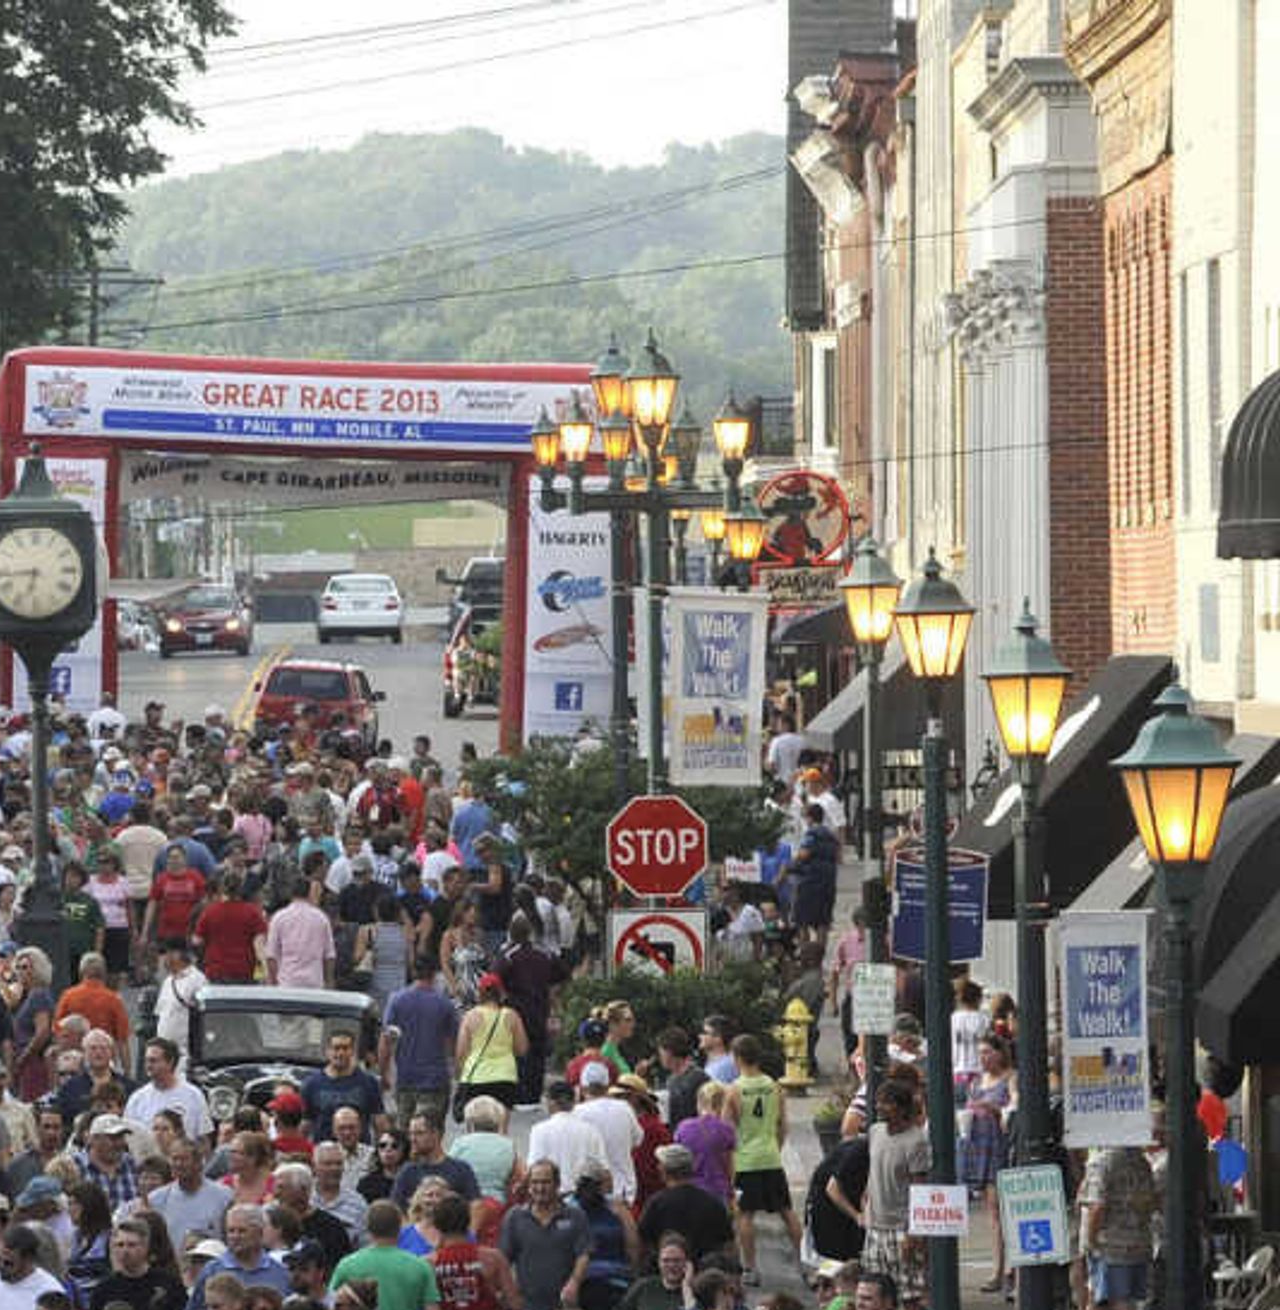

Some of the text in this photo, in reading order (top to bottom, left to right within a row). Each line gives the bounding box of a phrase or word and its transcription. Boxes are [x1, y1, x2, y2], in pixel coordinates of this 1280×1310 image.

[203, 383, 289, 409] GREAT
[299, 385, 371, 412] RACE
[380, 388, 440, 414] 2013
[220, 469, 269, 485] CAPE
[539, 532, 606, 546] HAGERTY
[696, 614, 738, 638] Walk
[703, 645, 732, 668] The
[615, 827, 700, 865] STOP
[1081, 949, 1126, 976] Walk
[1088, 979, 1122, 1005] The
